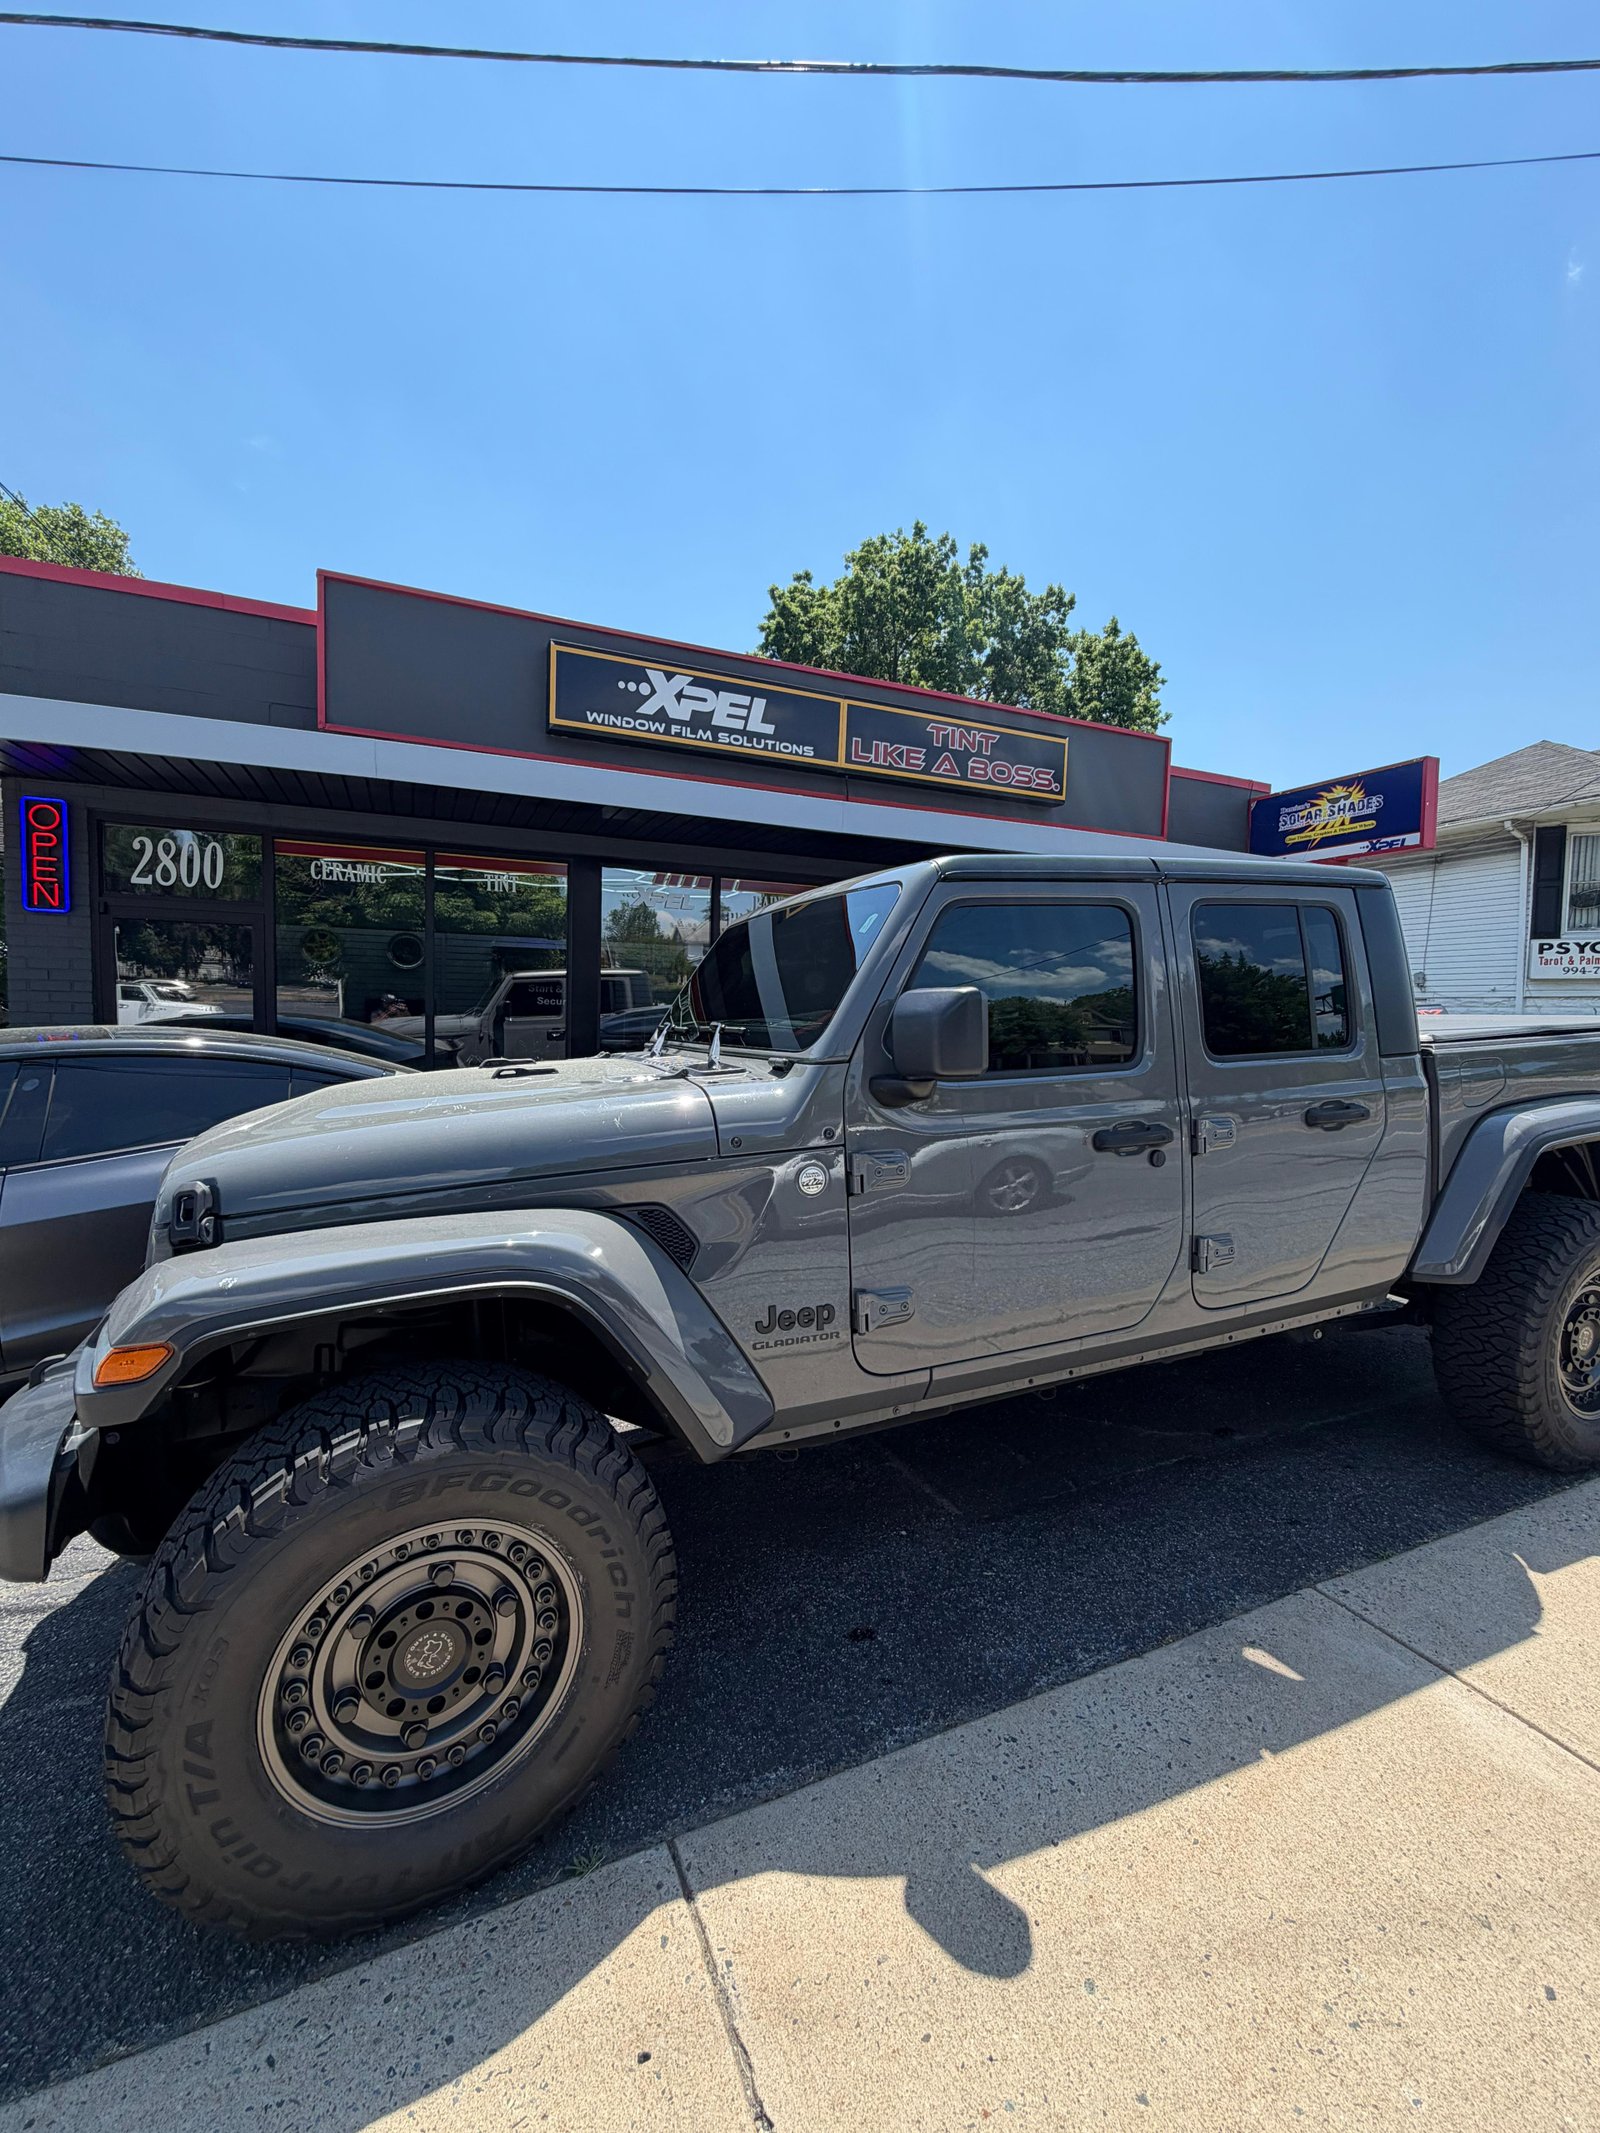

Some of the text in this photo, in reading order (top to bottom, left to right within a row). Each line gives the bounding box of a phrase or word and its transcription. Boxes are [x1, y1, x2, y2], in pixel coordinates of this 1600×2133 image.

[636, 668, 776, 735] XPEL
[586, 711, 814, 757] WINDOW FILM SOLUTIONS
[926, 723, 1000, 755] TINT
[851, 737, 1060, 792] LIKE A BOSS.
[1279, 808, 1323, 829] SOLAR
[1327, 795, 1383, 818] SHADES
[28, 804, 61, 908] OPEN
[130, 836, 224, 889] 2800
[310, 860, 518, 893] CERAMIC TINT
[630, 886, 695, 911] XPEL
[1538, 941, 1600, 955] PSYC
[1539, 956, 1563, 966] Tarot
[1568, 956, 1575, 966] &
[1562, 966, 1600, 975] 994-7
[528, 984, 554, 994] Start
[755, 1302, 836, 1335] Jeep
[752, 1331, 840, 1350] GLADIATOR
[385, 1469, 636, 1618] BFGoodrich
[183, 1719, 221, 1816] T/A
